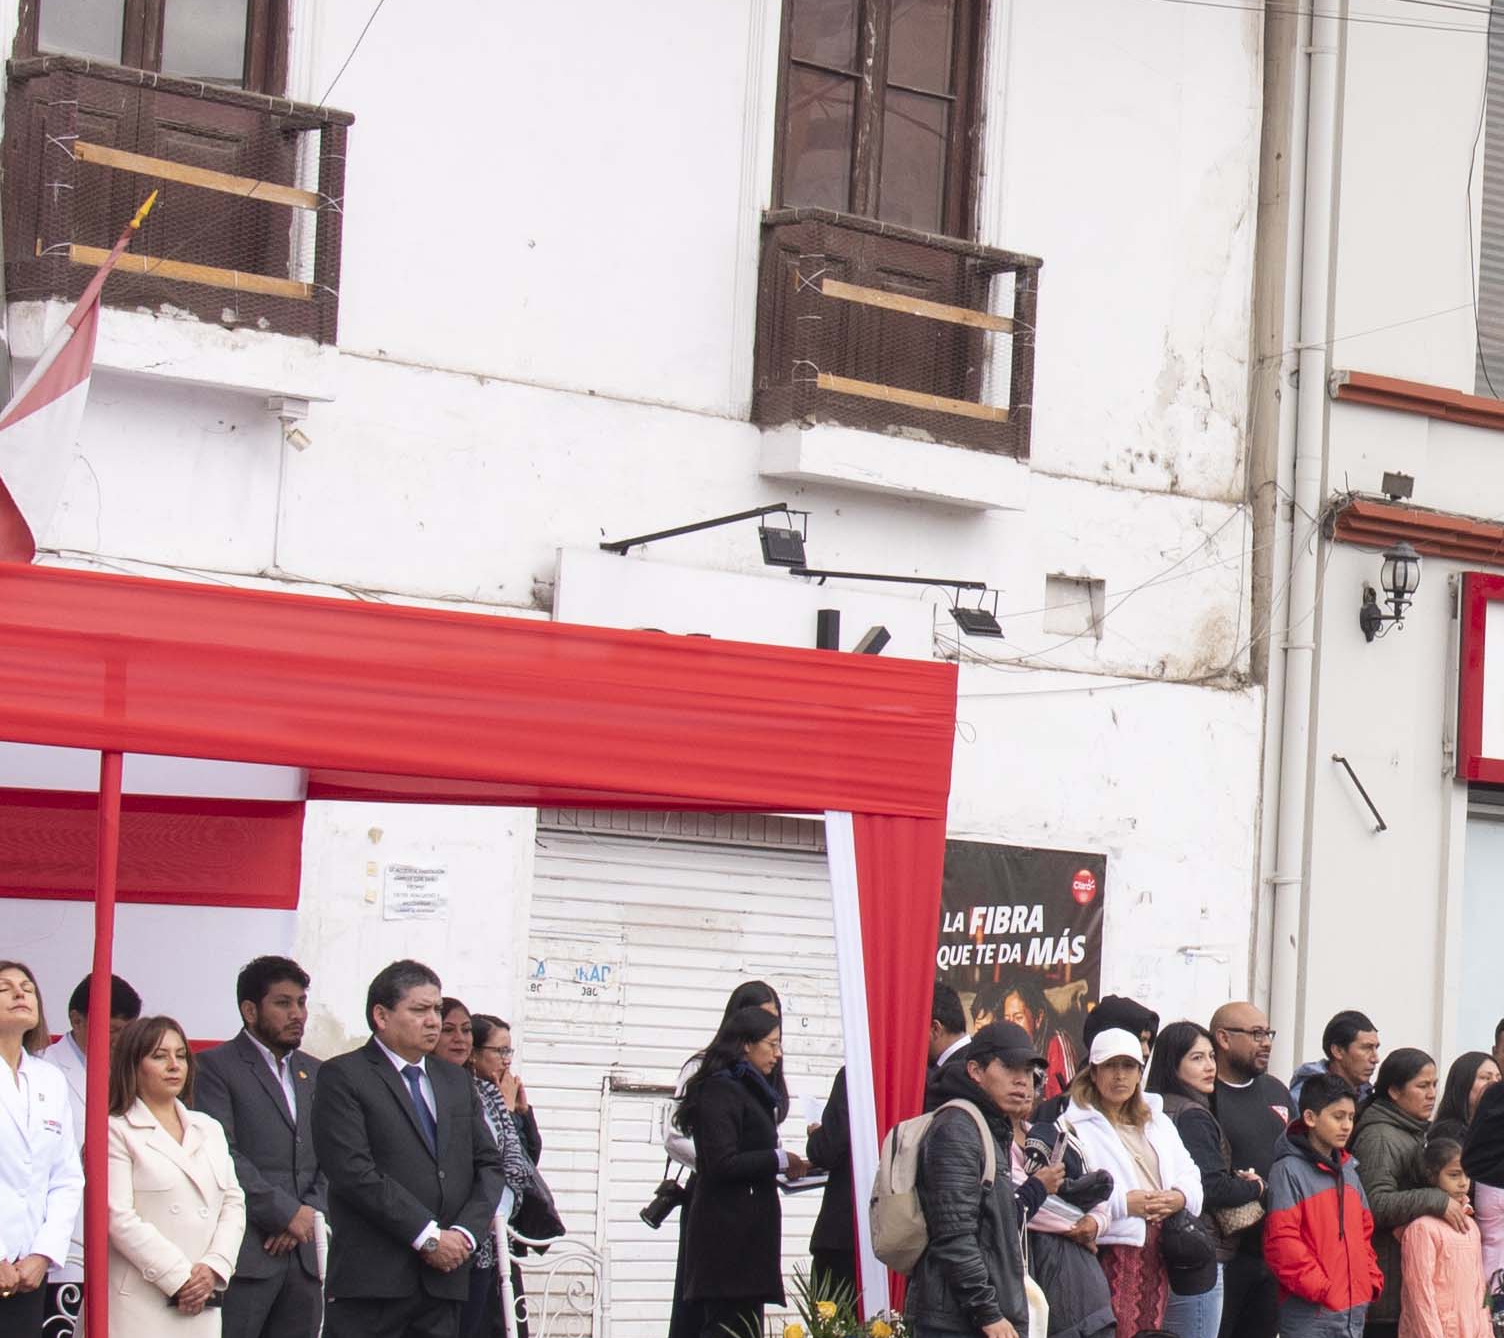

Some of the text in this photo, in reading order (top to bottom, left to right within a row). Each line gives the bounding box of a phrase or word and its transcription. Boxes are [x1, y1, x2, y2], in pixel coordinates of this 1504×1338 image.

[942, 904, 1044, 936] LA FIBRA
[936, 928, 1087, 971] QUE TE DA MÁS
